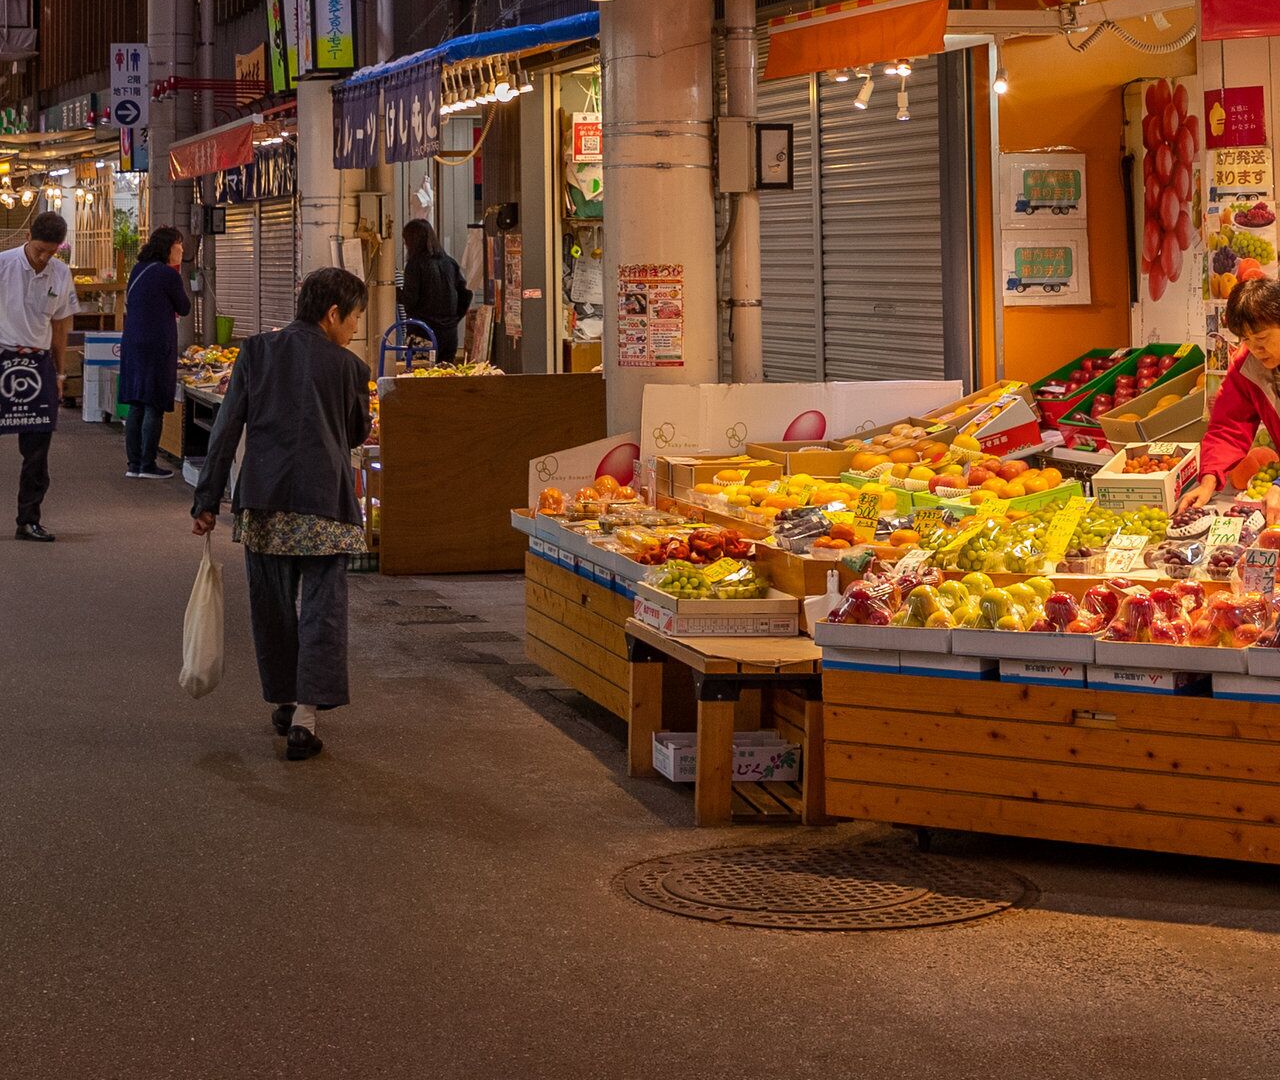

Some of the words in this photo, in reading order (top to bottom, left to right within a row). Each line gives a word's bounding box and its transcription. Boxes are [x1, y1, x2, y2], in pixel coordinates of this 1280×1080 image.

[127, 75, 141, 84] 2階
[113, 87, 141, 96] 地下1階
[2, 357, 39, 369] カナカン
[1246, 551, 1277, 567] 450
